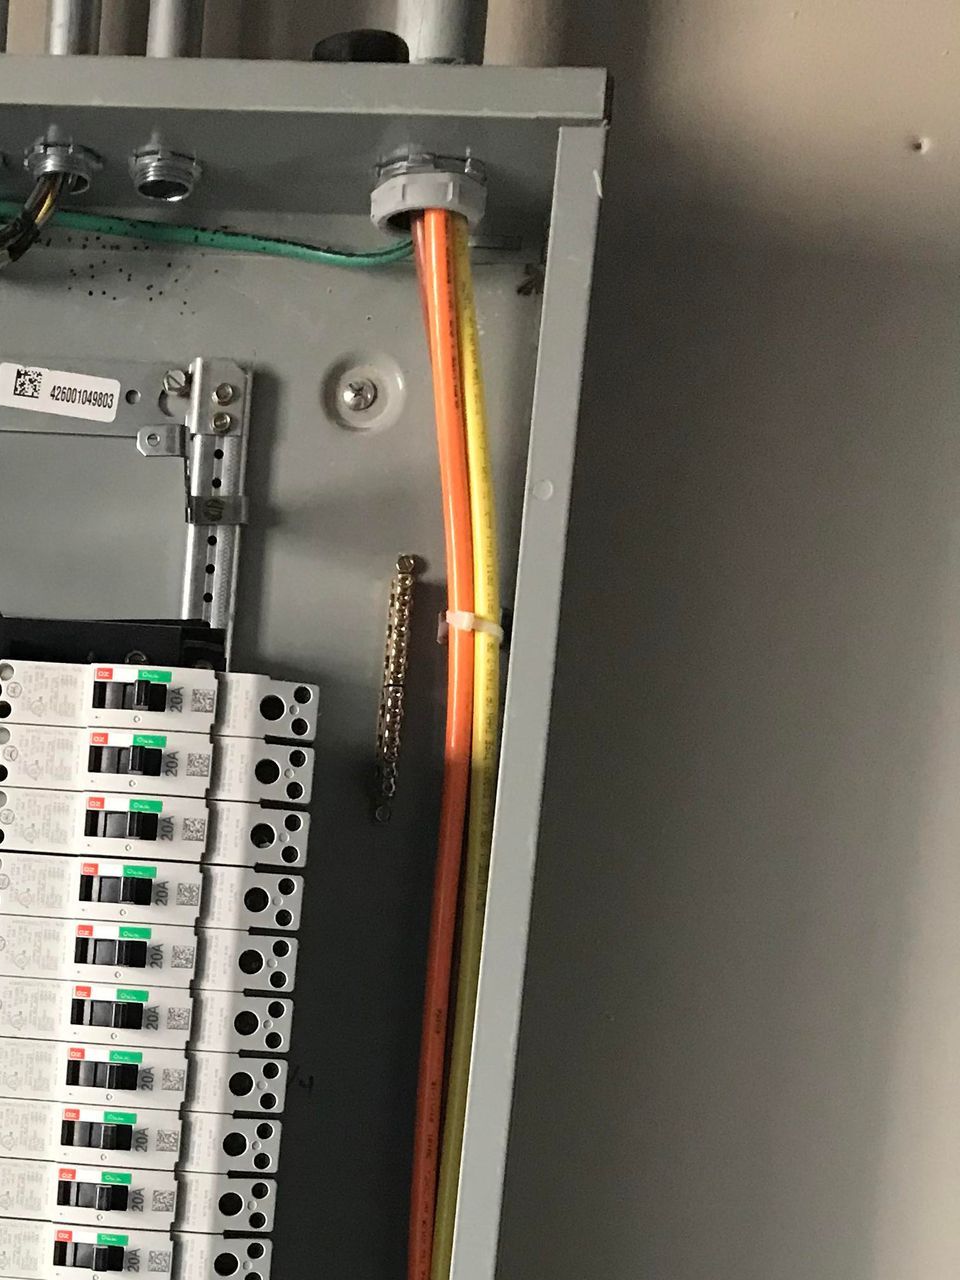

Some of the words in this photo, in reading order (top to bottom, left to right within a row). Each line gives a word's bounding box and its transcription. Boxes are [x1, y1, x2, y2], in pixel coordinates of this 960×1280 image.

[49, 385, 115, 409] 426001049803
[169, 687, 184, 713] 20A
[164, 751, 179, 777] 20A
[161, 816, 175, 841] 20A
[155, 881, 169, 906] 20A
[149, 944, 163, 969] 20A
[145, 1006, 160, 1031] 20A
[140, 1067, 154, 1091] 20A
[133, 1128, 149, 1152] 20A
[128, 1188, 144, 1212] 20A
[126, 1249, 140, 1272] 20A
